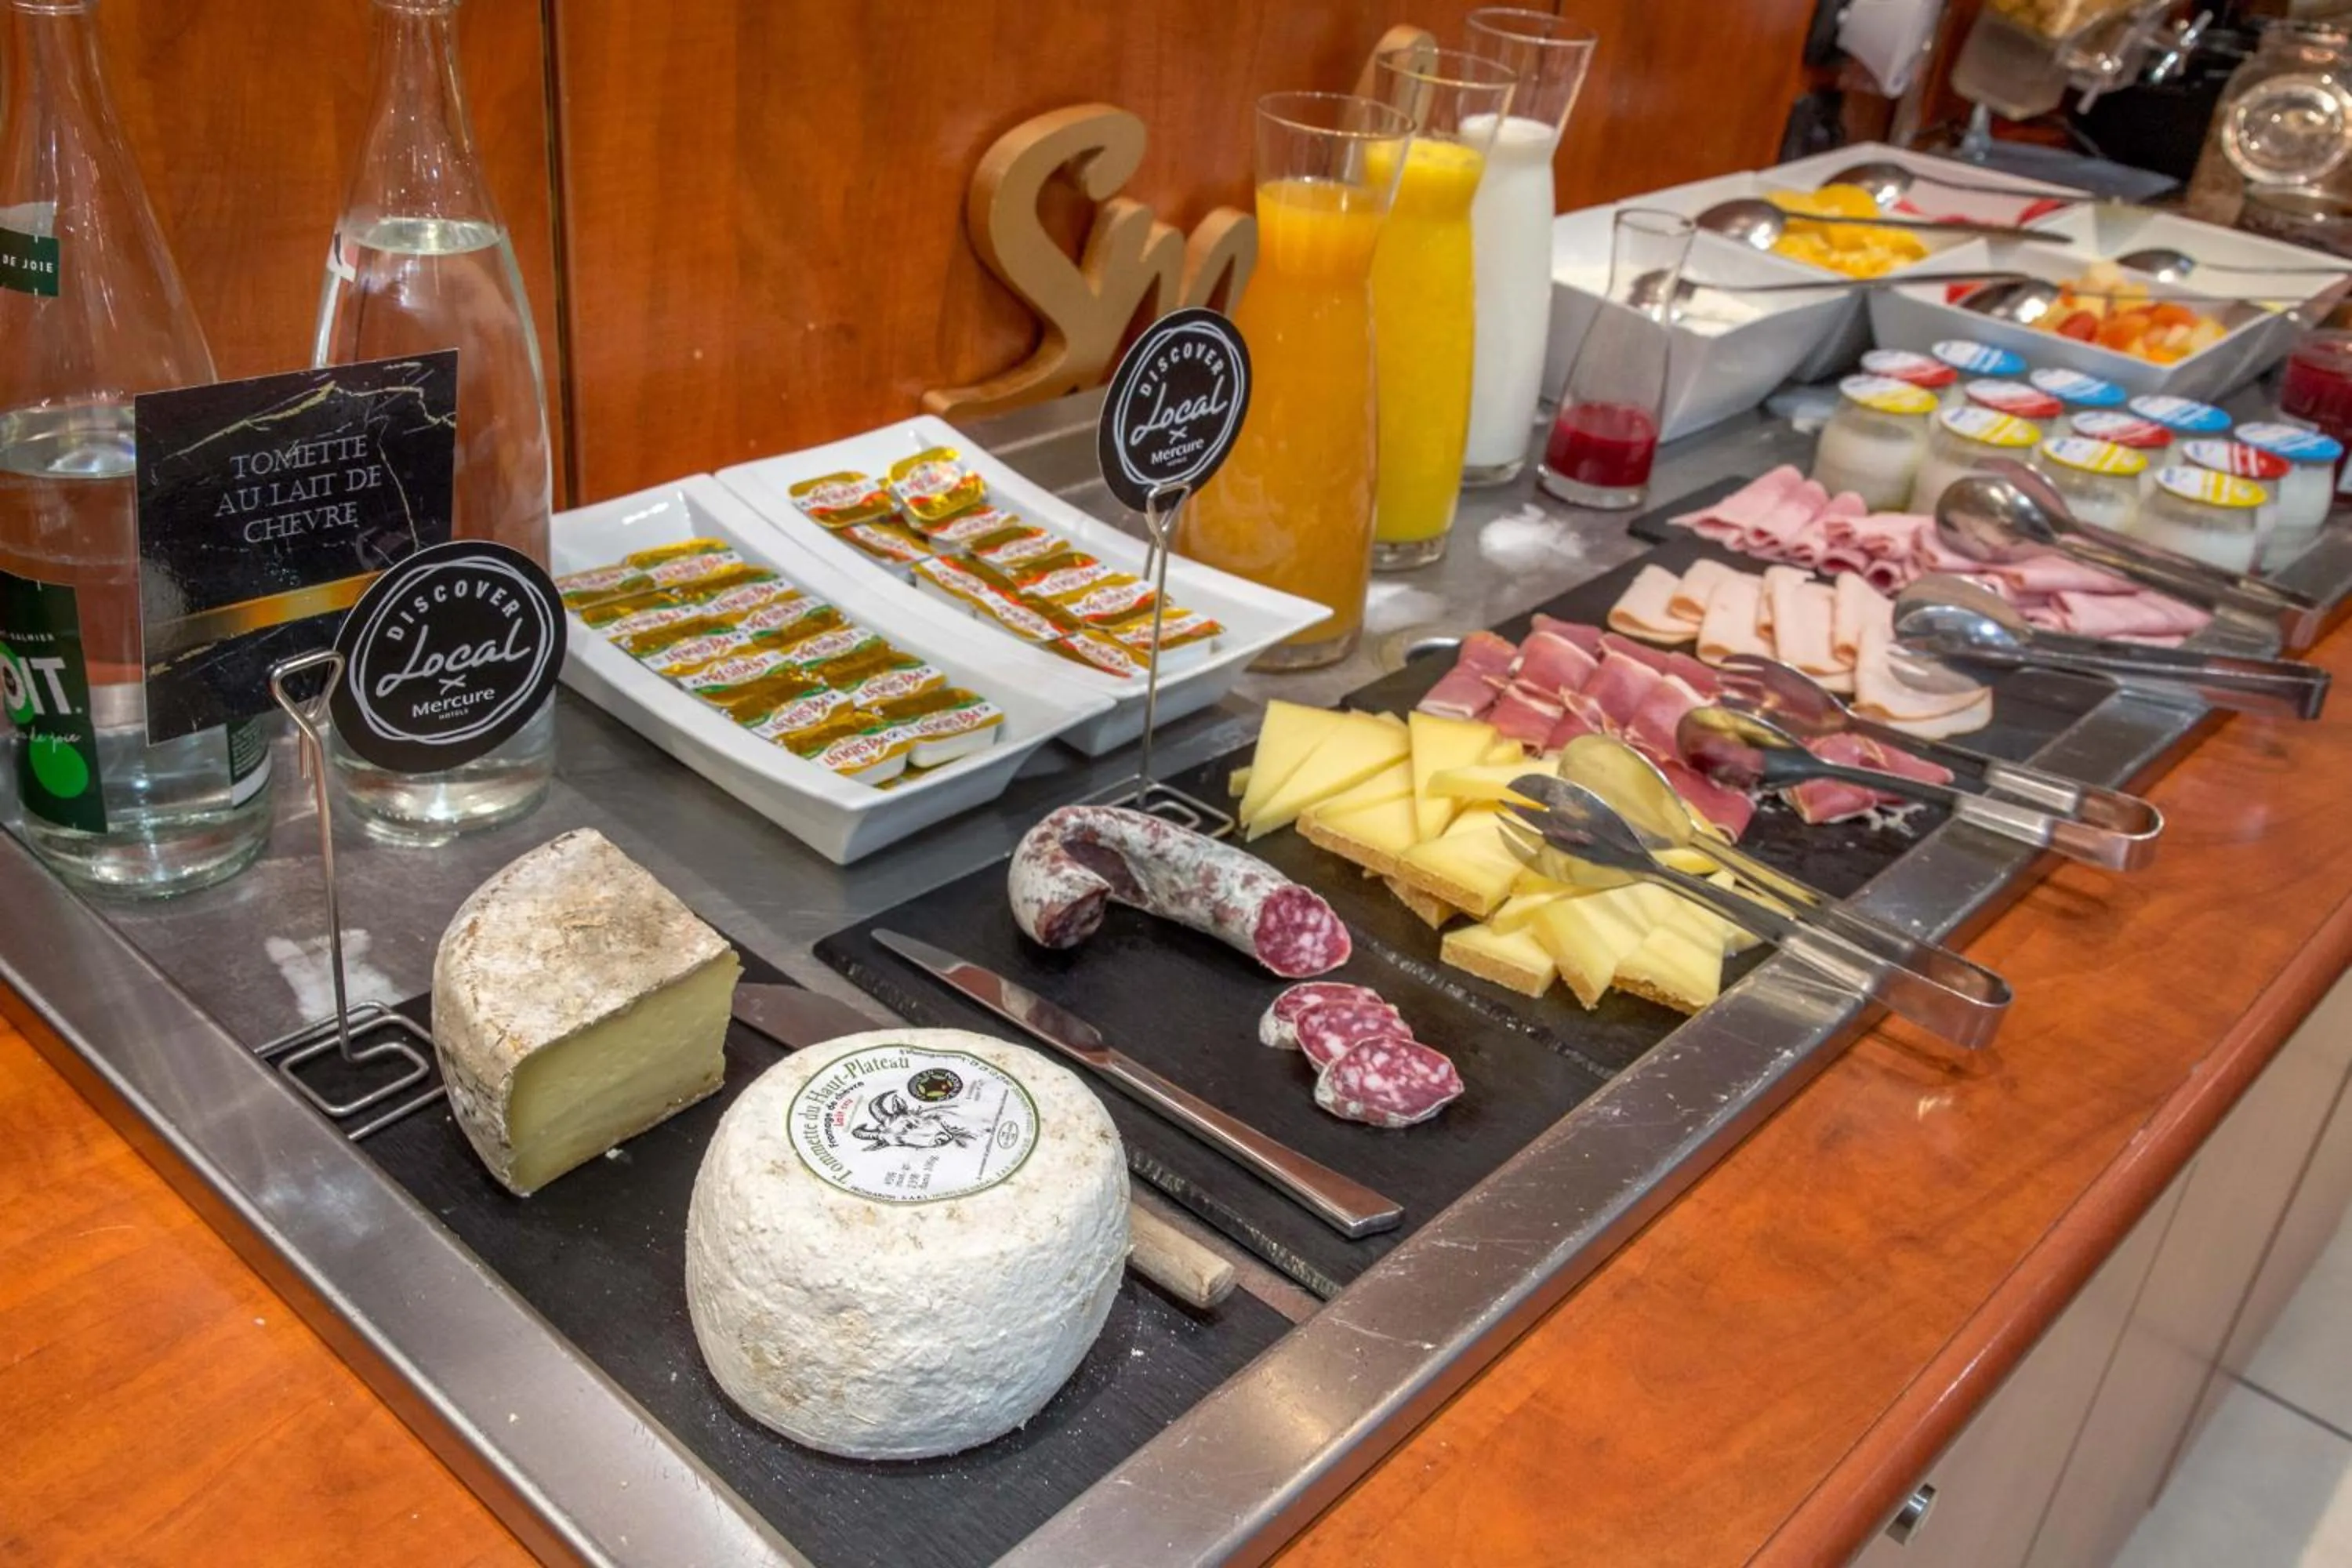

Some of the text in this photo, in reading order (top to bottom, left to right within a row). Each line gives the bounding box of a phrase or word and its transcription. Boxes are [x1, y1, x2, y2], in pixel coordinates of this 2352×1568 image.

[2, 253, 54, 274] DE JOIE
[1139, 341, 1225, 397] DISCOVER
[1129, 374, 1229, 447] Local
[229, 434, 368, 480] TOMETTE
[1150, 438, 1205, 465] Mercure
[213, 464, 383, 517] AU LAIT DE
[243, 501, 358, 544] CHEVRE
[387, 579, 521, 641] DISCOVER
[376, 617, 532, 699] Local
[412, 687, 496, 718] Mercure
[805, 1056, 909, 1102] Haut-Plateau
